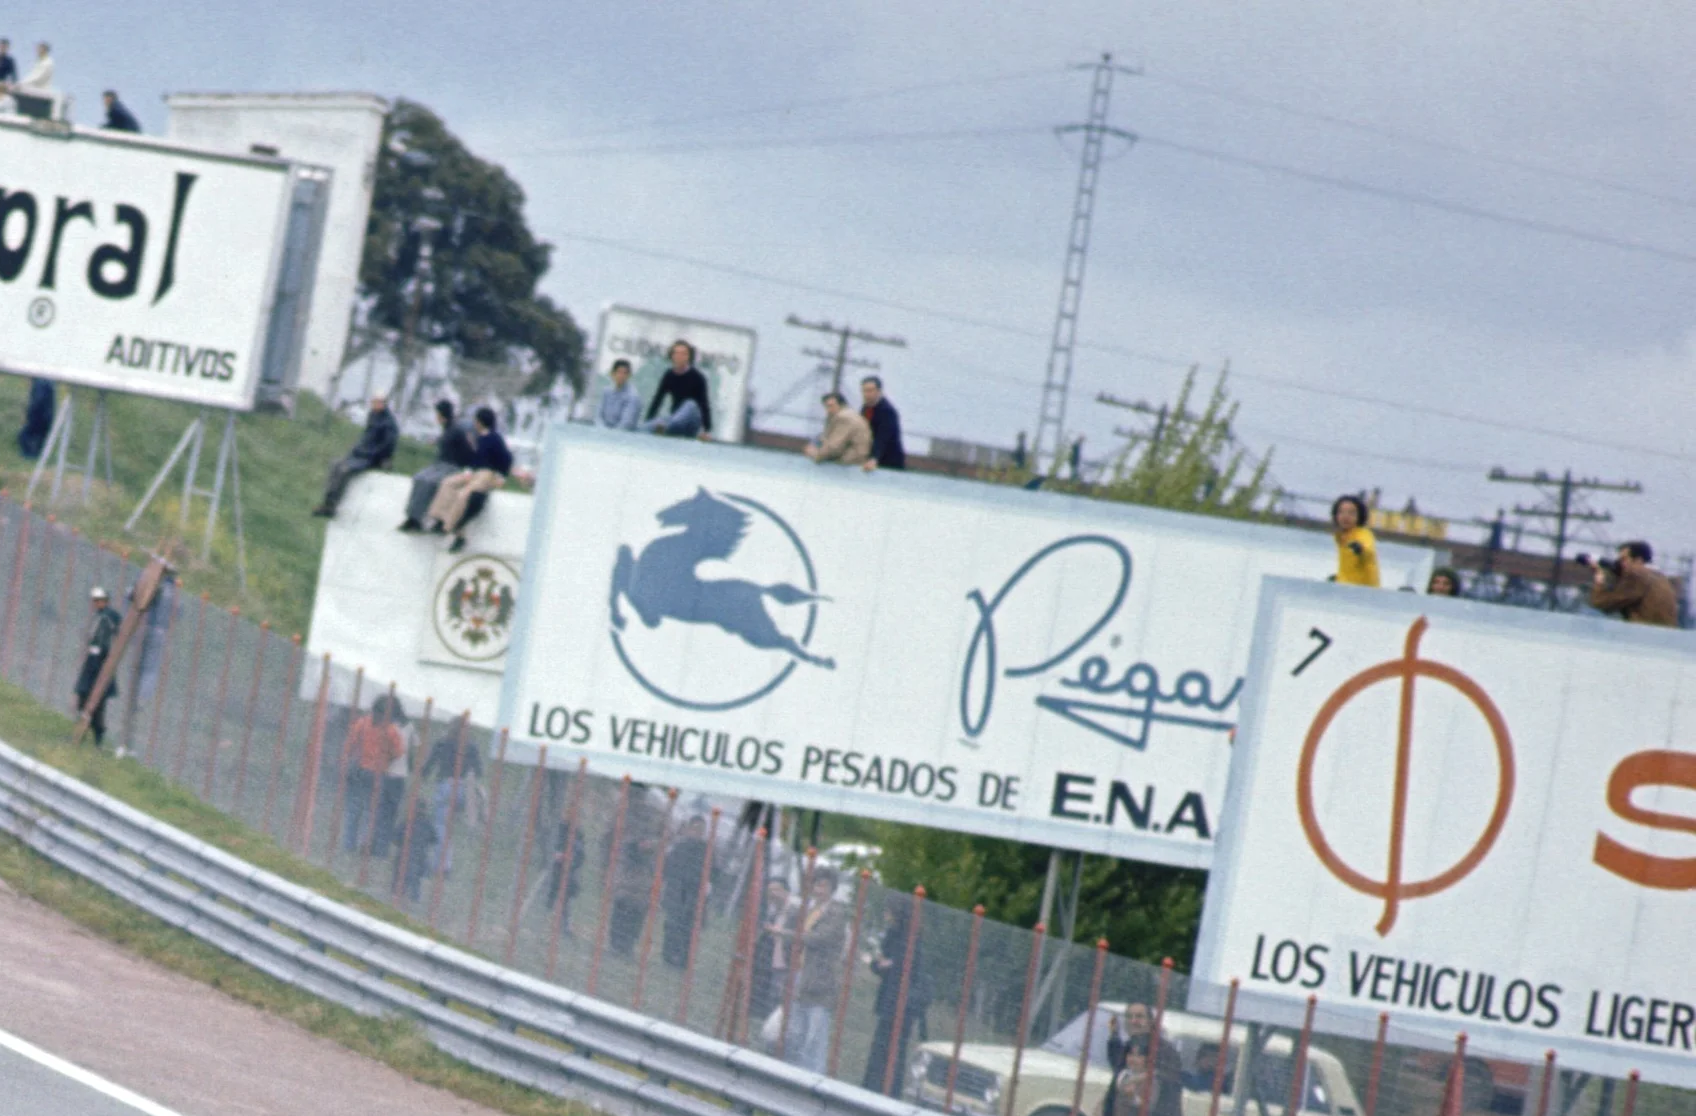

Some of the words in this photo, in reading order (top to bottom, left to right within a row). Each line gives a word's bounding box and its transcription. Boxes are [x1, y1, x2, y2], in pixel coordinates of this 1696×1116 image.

[104, 333, 238, 383] ADITIVOS
[527, 701, 594, 751] LOS
[609, 714, 785, 776] VEHICULOS
[800, 745, 958, 803] PESADOS
[977, 771, 1021, 811] DE
[1249, 933, 1330, 990] LOS
[1348, 950, 1563, 1030] VEHICULOS
[1584, 989, 1696, 1052] LIGER
